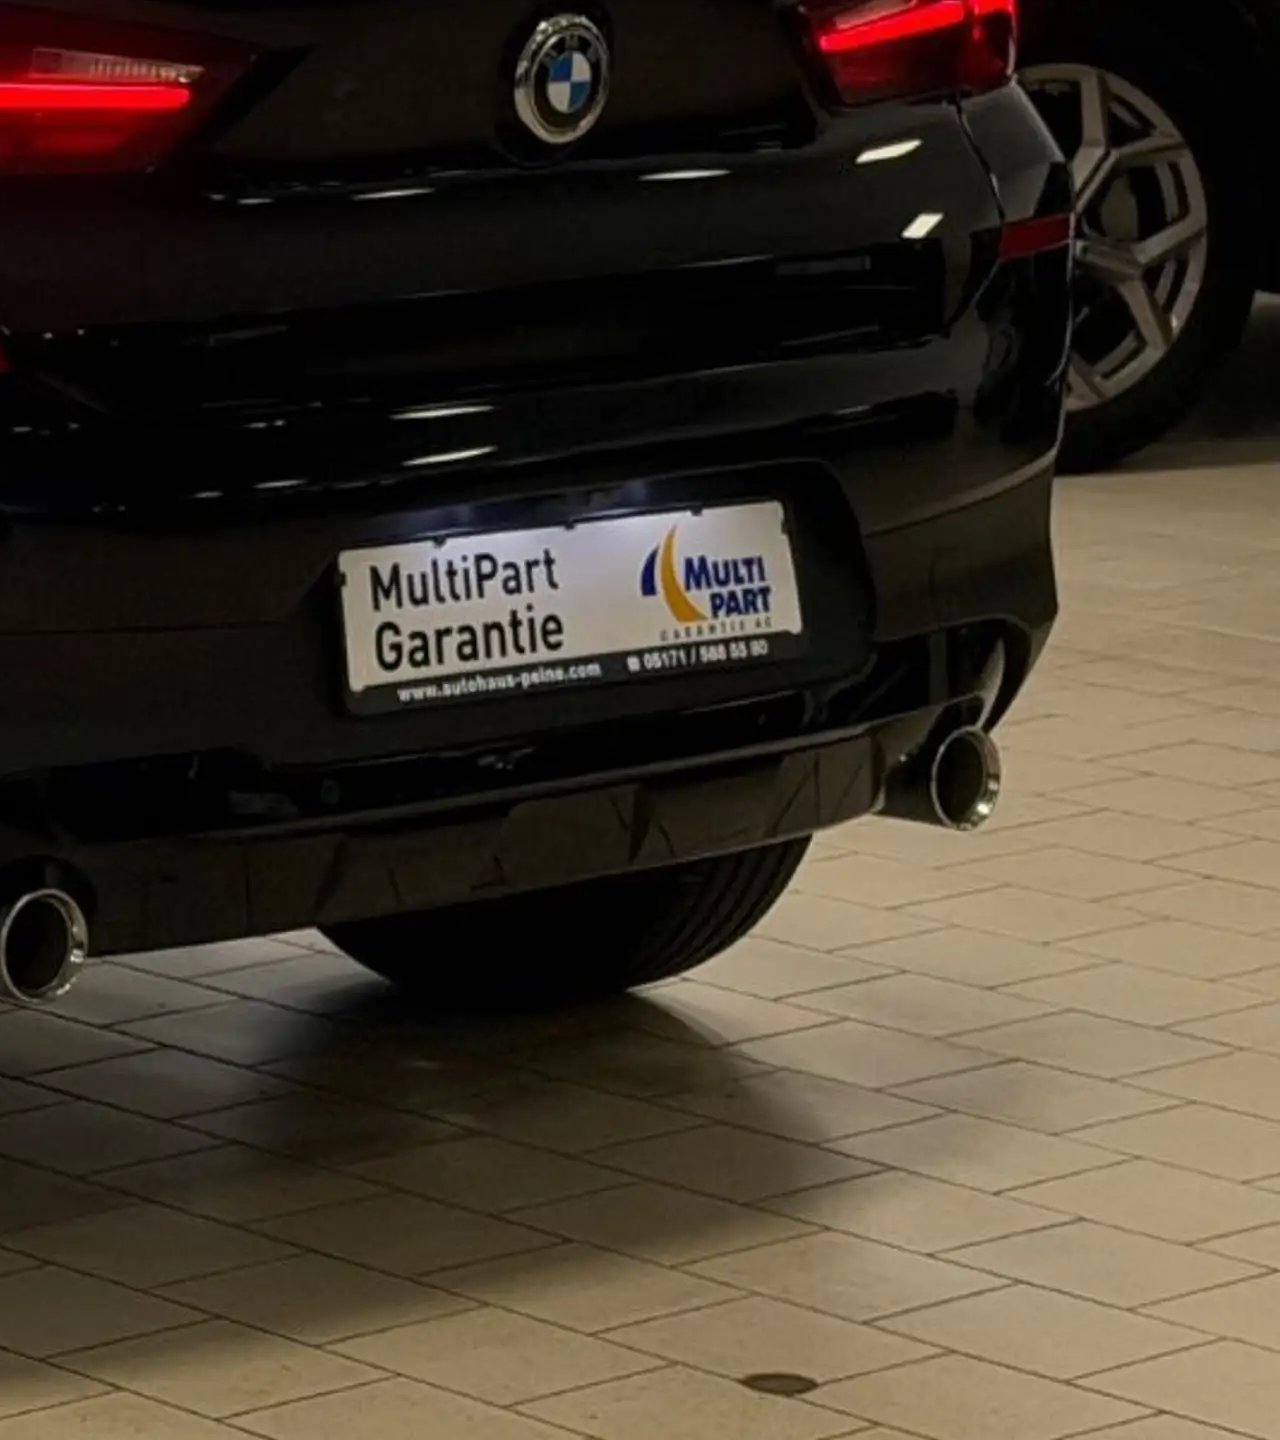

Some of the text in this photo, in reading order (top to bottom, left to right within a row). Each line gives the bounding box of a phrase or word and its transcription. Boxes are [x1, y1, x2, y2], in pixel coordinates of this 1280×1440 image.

[369, 548, 560, 612] MultiPart
[684, 554, 767, 593] MULTI
[710, 585, 772, 620] PART
[375, 603, 564, 673] Garantie
